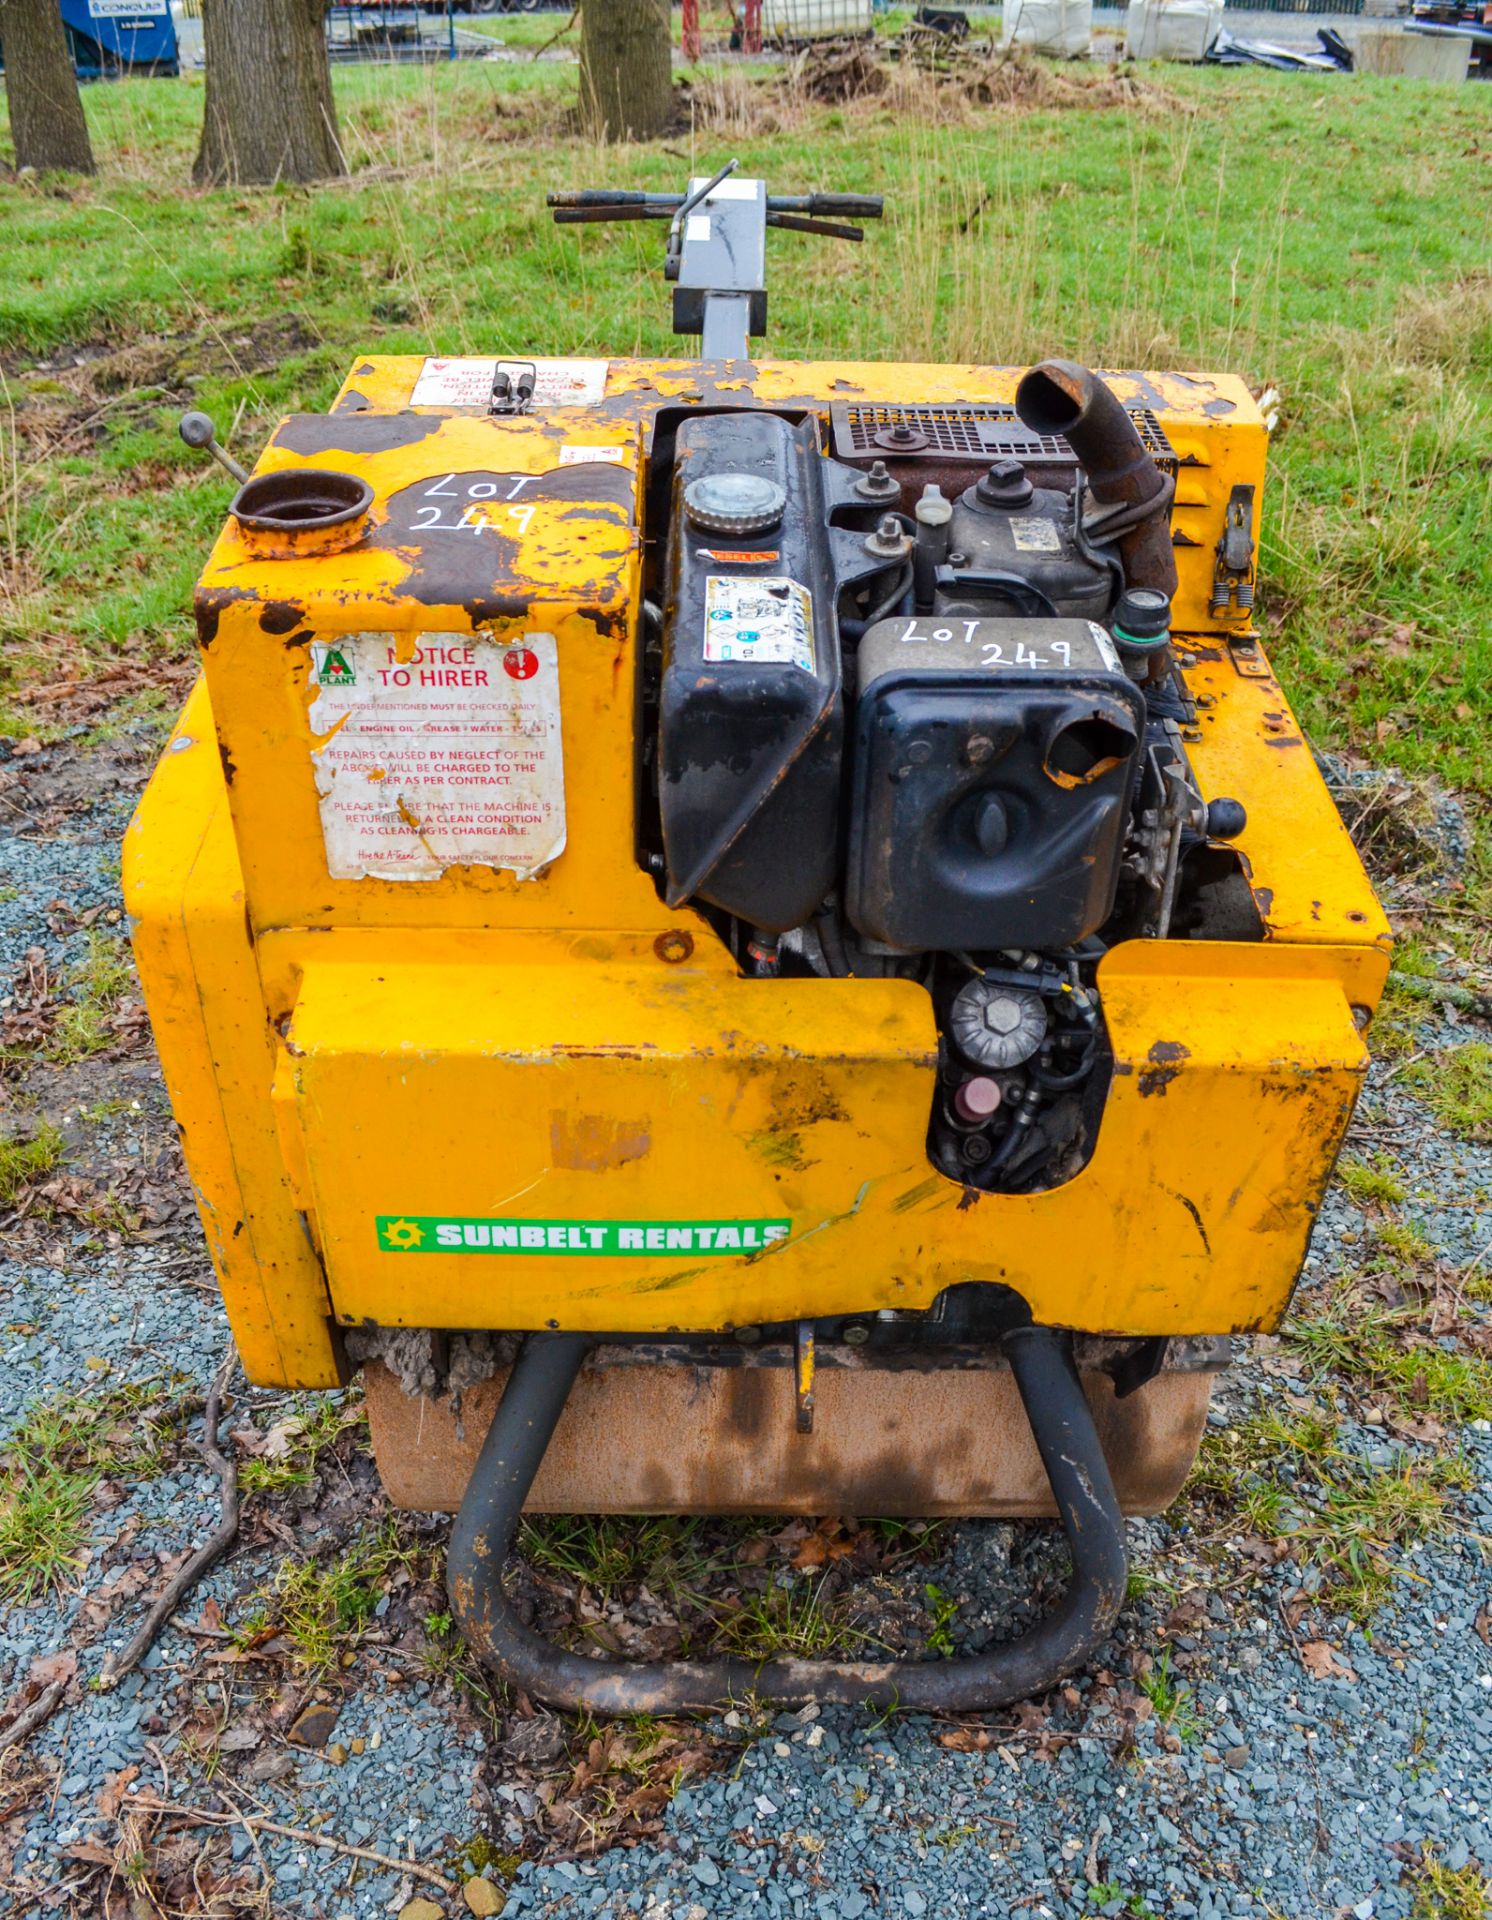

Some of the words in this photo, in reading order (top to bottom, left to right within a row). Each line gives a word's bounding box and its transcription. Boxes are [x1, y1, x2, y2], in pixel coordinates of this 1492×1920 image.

[409, 505, 537, 536] 249
[980, 641, 1071, 669] 249
[319, 676, 356, 685] PLANT
[377, 669, 411, 687] TO
[420, 669, 489, 687] HIRER
[329, 703, 344, 711] THE
[430, 703, 455, 711] MUST
[457, 703, 467, 711] BE
[469, 703, 509, 711] CHECKED
[511, 703, 536, 711] DAILY
[328, 751, 376, 760] REPAIRS
[379, 751, 426, 760] CAUSED
[430, 751, 444, 760] BY
[449, 751, 501, 760] NEGLECT
[504, 751, 520, 760] OF
[524, 751, 545, 760] THE
[416, 763, 431, 772] BE
[434, 763, 491, 772] CHARGED
[494, 763, 511, 772] TO
[513, 763, 537, 772] THE
[405, 776, 420, 785] AS
[423, 776, 444, 785] PER
[448, 776, 512, 785] CONTRACT.
[426, 802, 455, 811] THAT
[459, 802, 480, 811] THE
[484, 802, 539, 811] MACHINE
[542, 802, 552, 811] IS
[424, 815, 433, 823] A
[436, 815, 474, 824] CLEAN
[477, 815, 542, 824] CONDITION
[360, 826, 375, 835] AS
[438, 826, 448, 835] IS
[435, 1223, 608, 1249] SUNBELT
[617, 1225, 791, 1250] RENTALS
